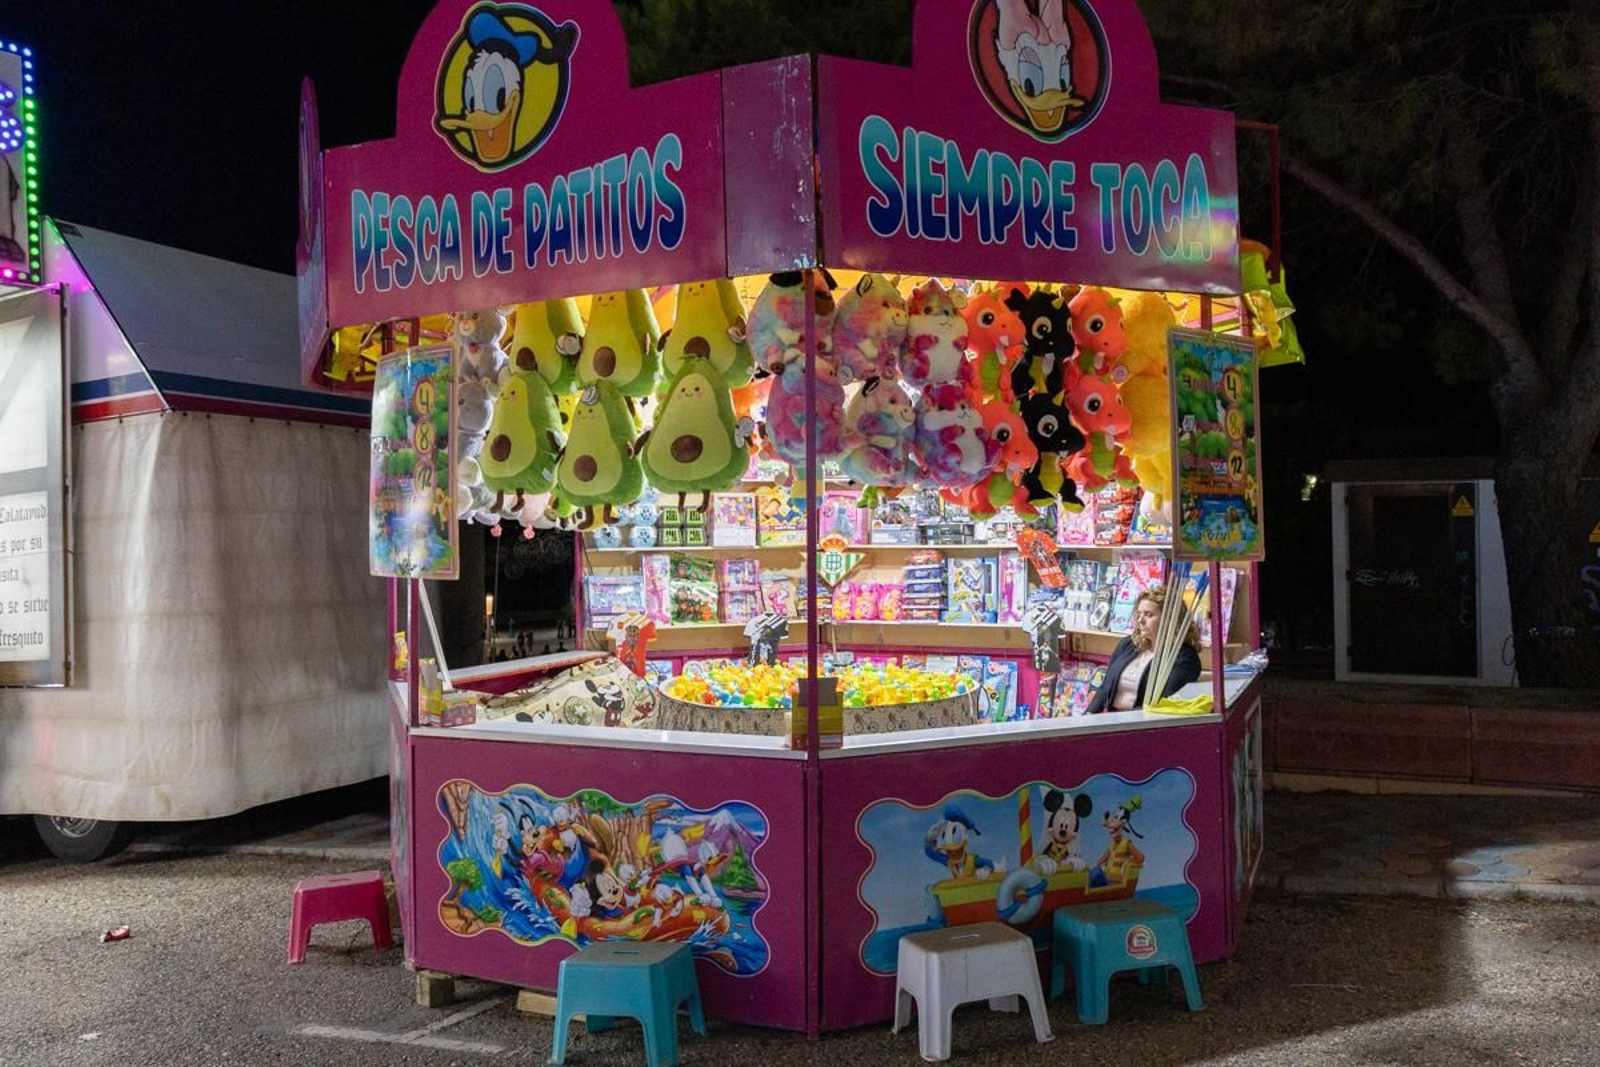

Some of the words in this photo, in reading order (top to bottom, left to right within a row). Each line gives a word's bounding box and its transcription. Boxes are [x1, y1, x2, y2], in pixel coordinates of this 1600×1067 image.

[858, 115, 1078, 251] SIEMPRE
[1091, 153, 1213, 262] TOCA
[351, 188, 464, 294] PESCA
[471, 187, 515, 278] DE
[523, 132, 687, 269] PATITOS
[419, 387, 430, 412] 4
[1227, 374, 1236, 399] 4
[419, 421, 430, 450] 8
[11, 539, 26, 555] por
[30, 536, 42, 551] su
